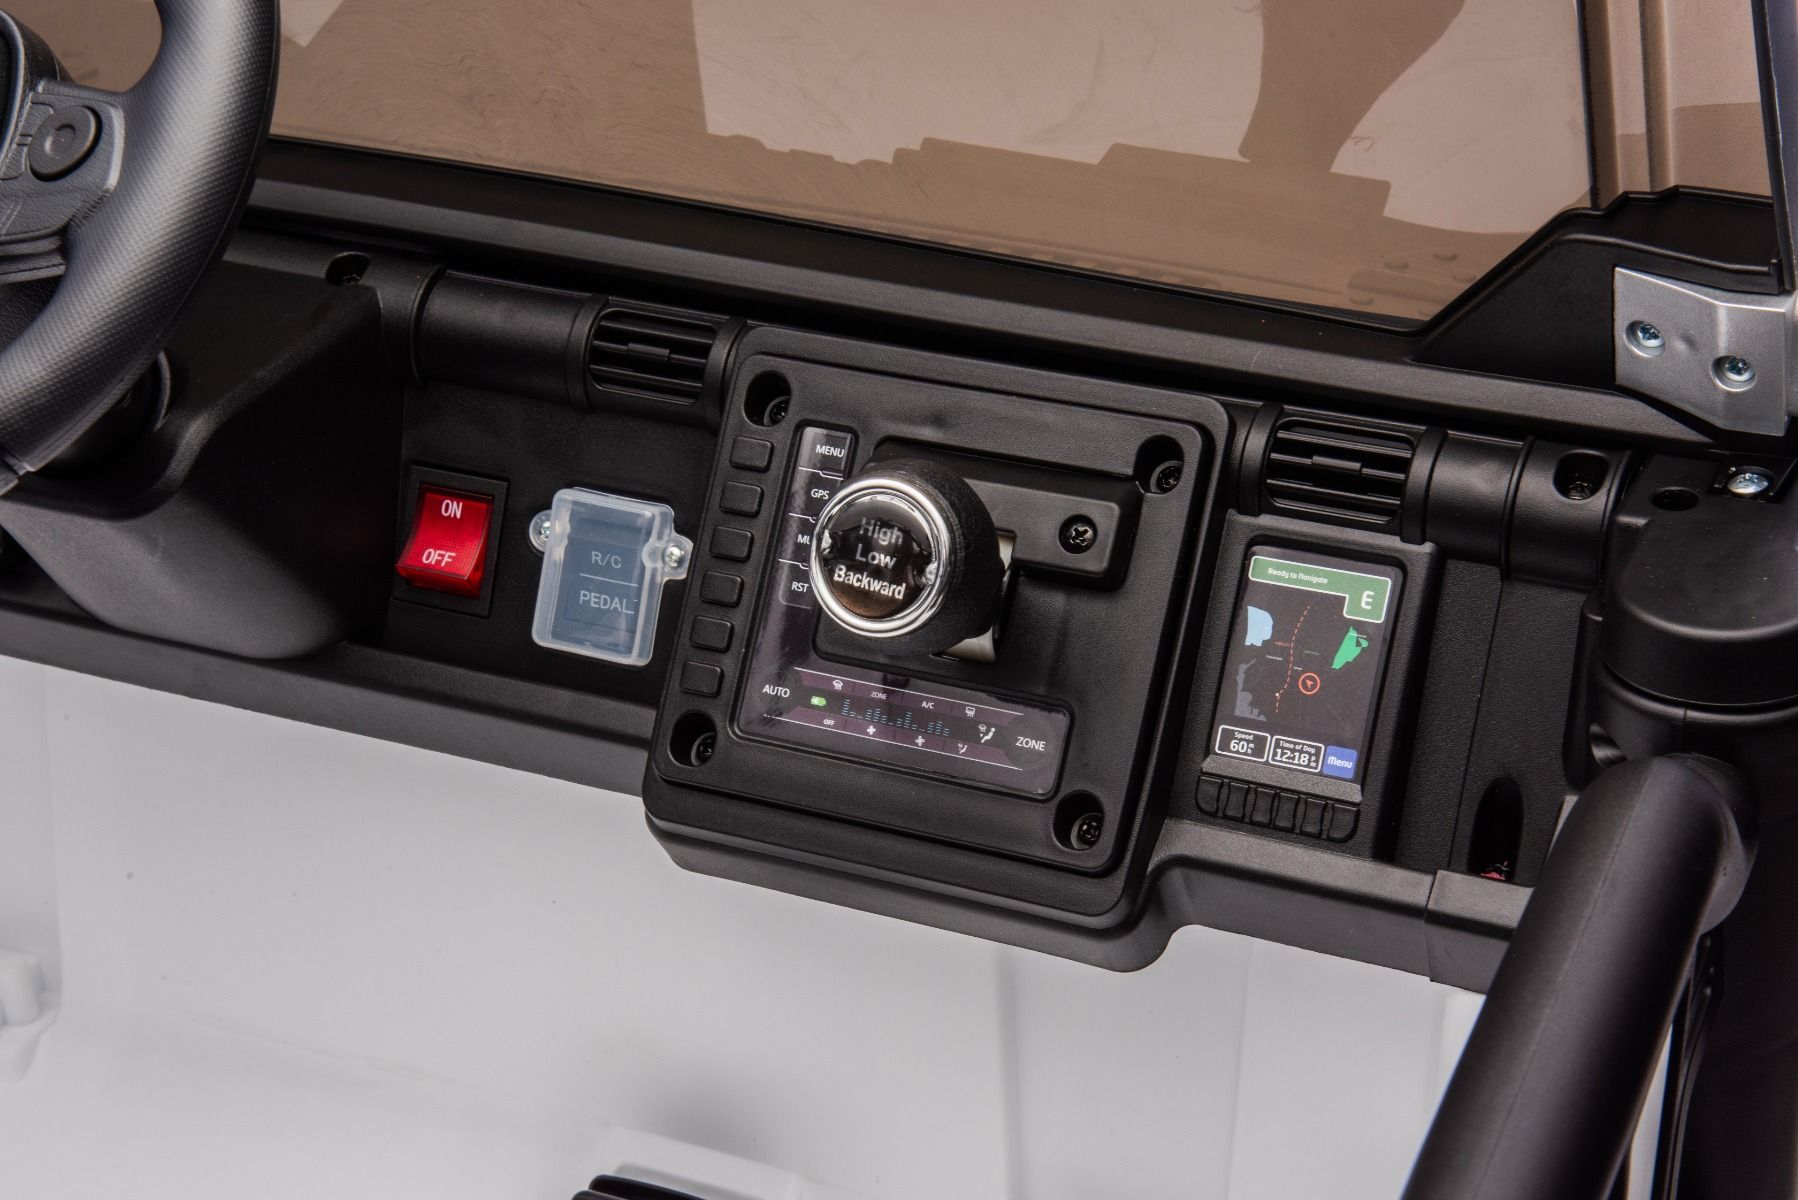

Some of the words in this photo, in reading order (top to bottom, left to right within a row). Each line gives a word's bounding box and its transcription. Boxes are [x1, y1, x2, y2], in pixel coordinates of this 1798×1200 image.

[815, 444, 845, 458] MENU
[811, 488, 830, 500] GPS
[441, 500, 463, 519] ON
[859, 517, 904, 546] High
[422, 548, 456, 568] OFF
[855, 543, 897, 570] Low
[833, 564, 906, 600] Backward
[1267, 567, 1289, 579] Ready
[1298, 572, 1328, 585] Navigate
[791, 581, 810, 593] RST
[580, 590, 635, 615] PEDAL
[1360, 590, 1375, 611] E
[762, 684, 790, 699] AUTO
[870, 690, 888, 700] ZONE
[921, 700, 935, 710] A/C
[823, 718, 836, 726] OFF
[1234, 731, 1254, 741] Speed
[1015, 736, 1046, 752] ZONE
[1229, 739, 1248, 754] 60
[1279, 740, 1295, 749] Time
[1303, 745, 1317, 754] Day
[1274, 748, 1310, 766] 12:18
[1327, 756, 1353, 769] Menu
